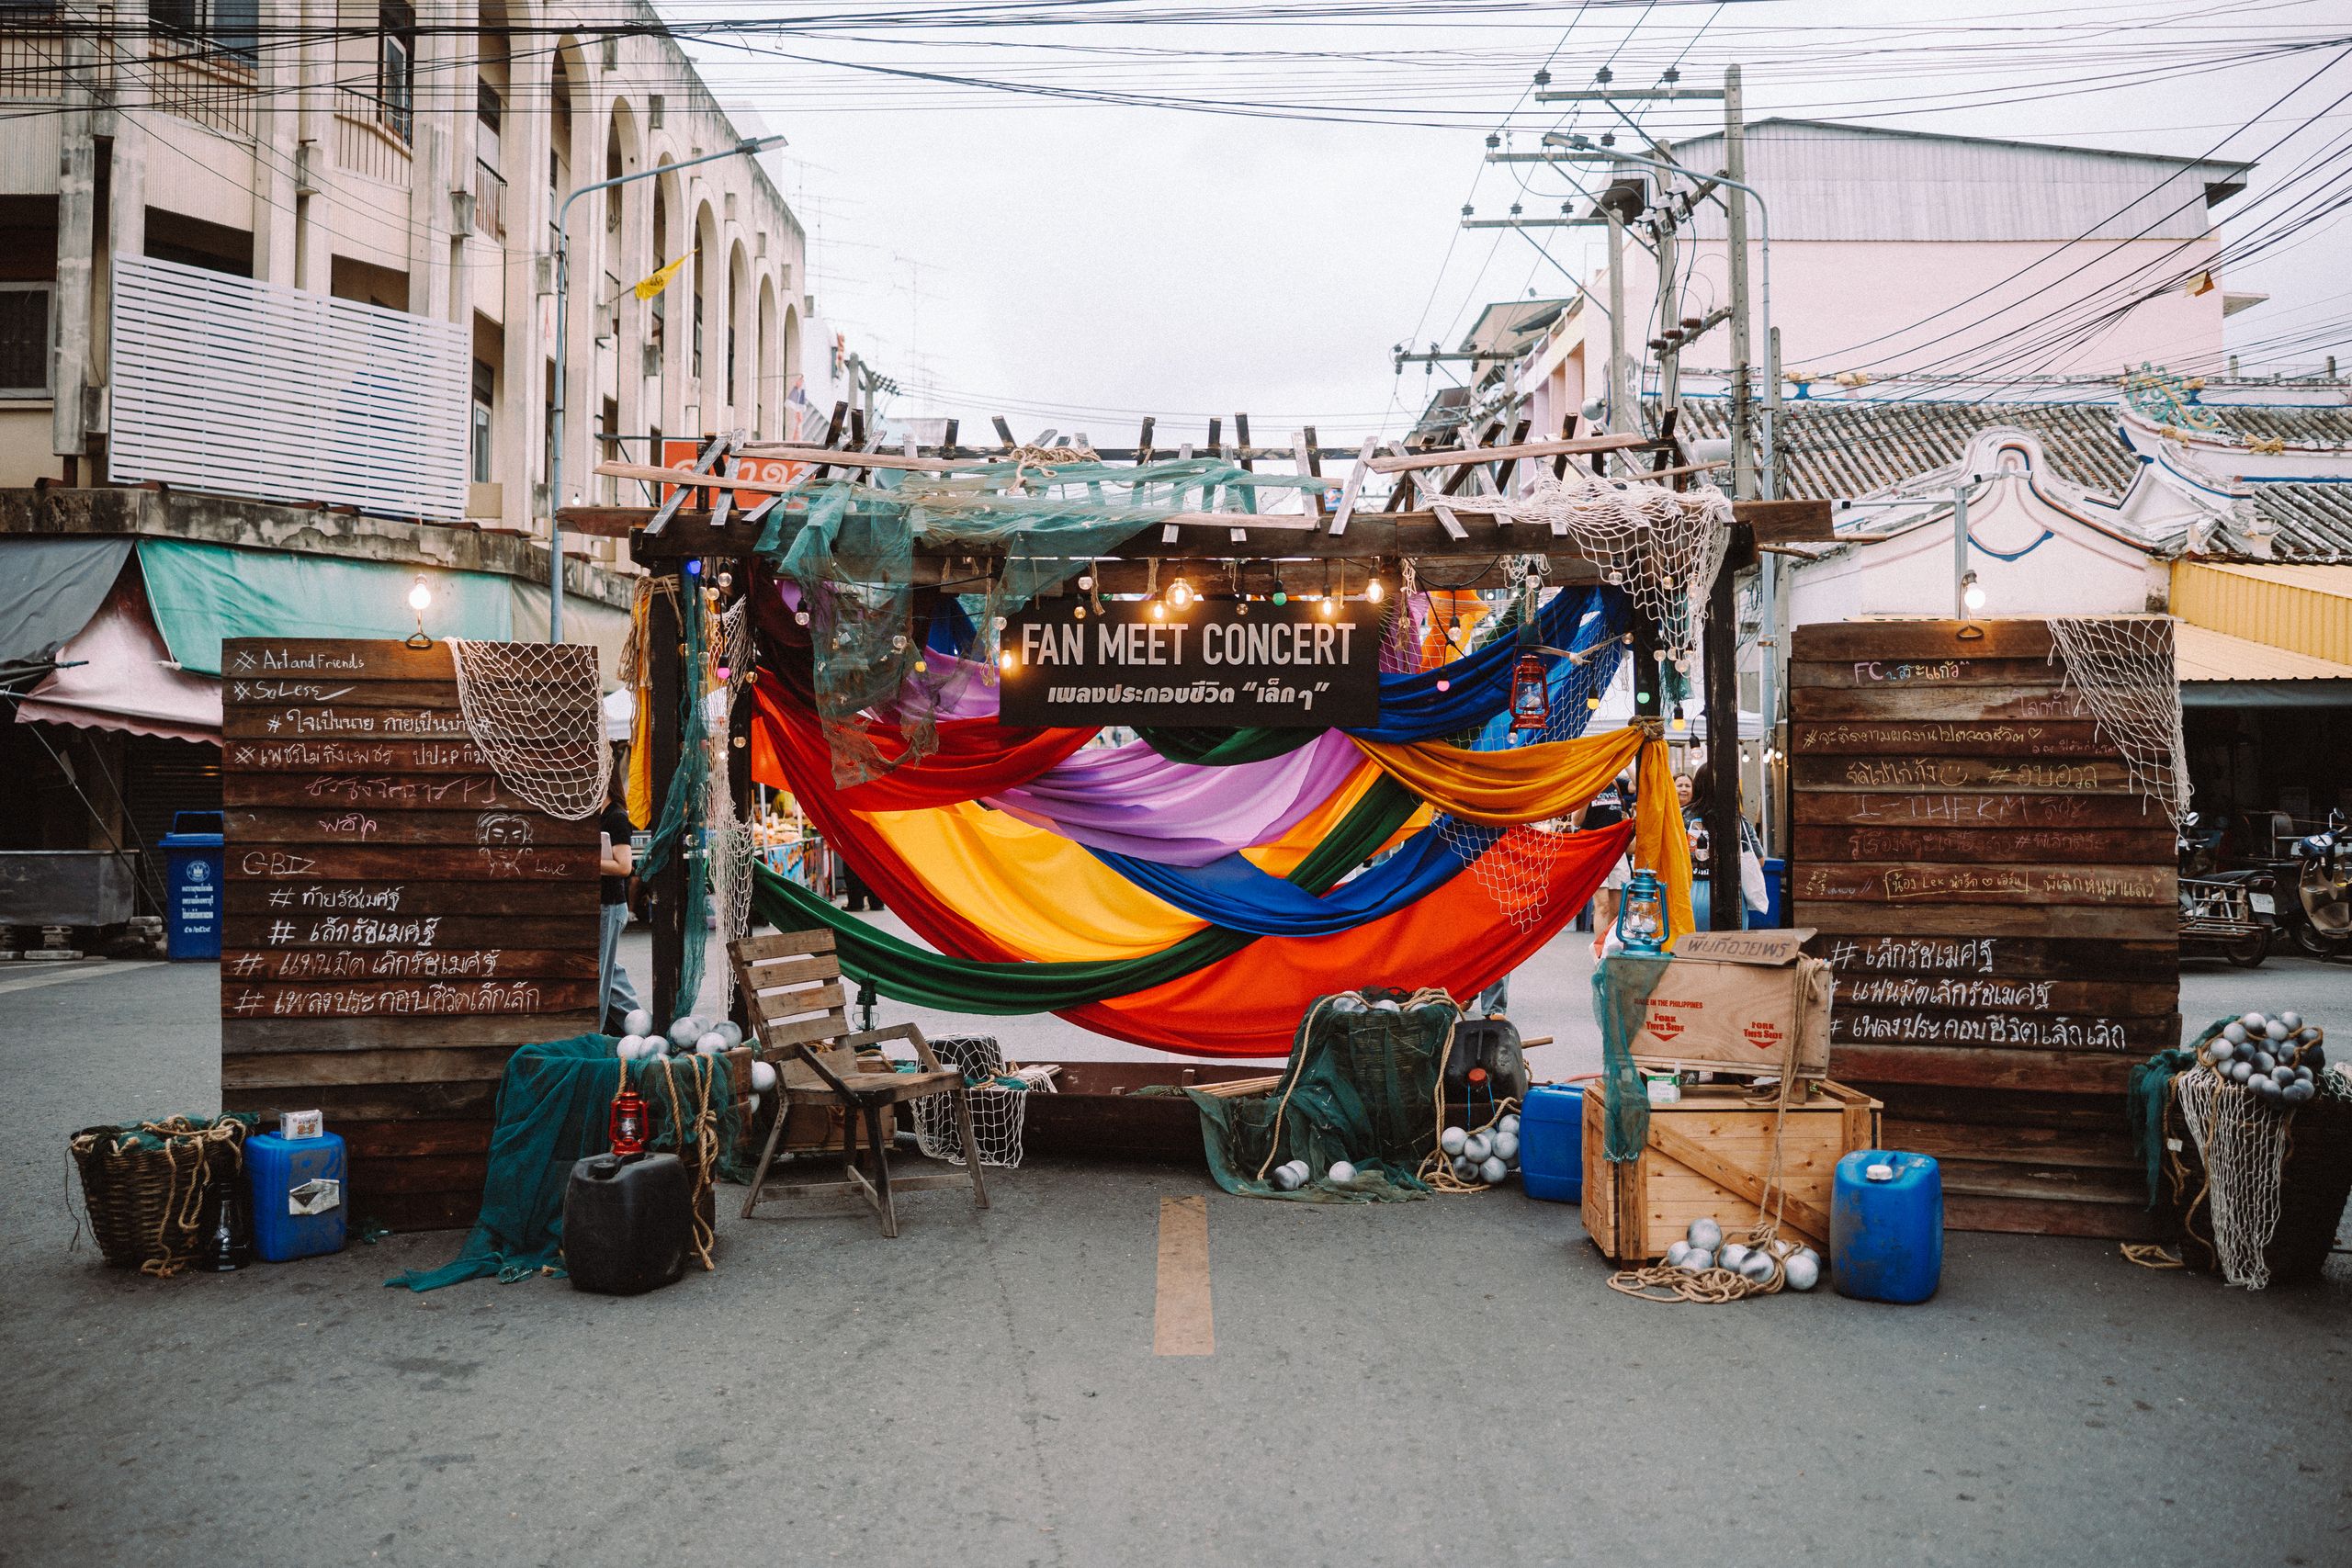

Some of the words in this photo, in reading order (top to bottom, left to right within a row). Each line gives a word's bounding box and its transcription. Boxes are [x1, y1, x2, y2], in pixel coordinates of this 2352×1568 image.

[1022, 623, 1084, 666] FAN
[1098, 623, 1189, 666] MEET
[1202, 623, 1357, 666] CONCERT
[1854, 661, 1883, 684] FC
[1047, 681, 1236, 704] เพลงประกอบชีวิต
[1650, 998, 1657, 1007] IN
[1657, 998, 1668, 1008] THE
[1669, 999, 1703, 1010] PHILIPPINES
